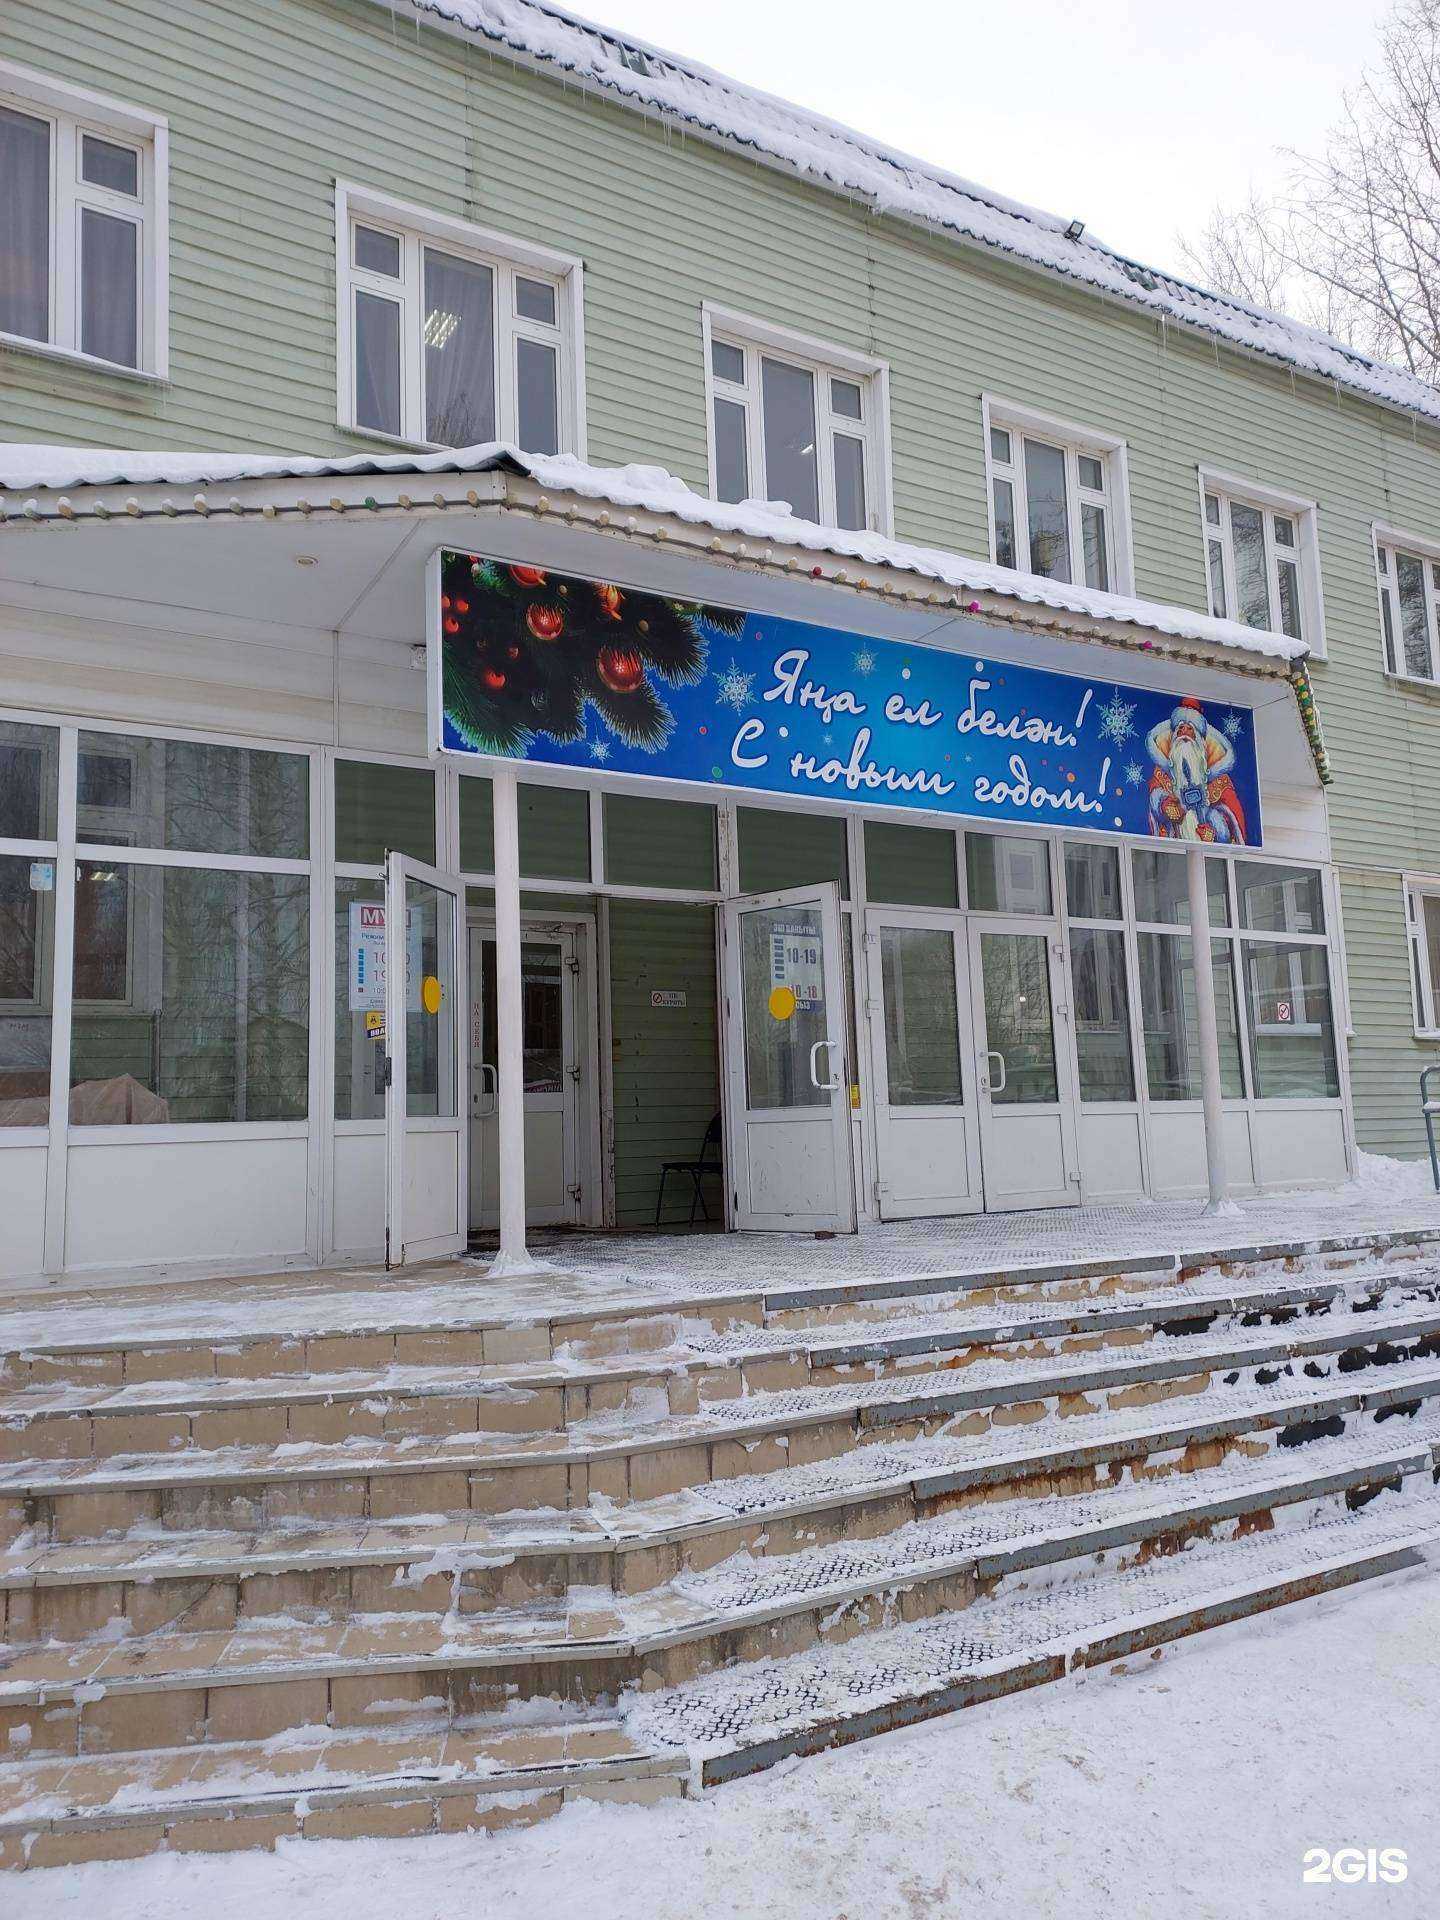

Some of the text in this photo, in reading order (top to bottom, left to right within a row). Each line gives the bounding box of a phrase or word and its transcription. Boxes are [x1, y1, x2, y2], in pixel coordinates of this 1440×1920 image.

[763, 650, 1093, 747] Яңа ел белән!
[731, 718, 1112, 813] С новым годом!
